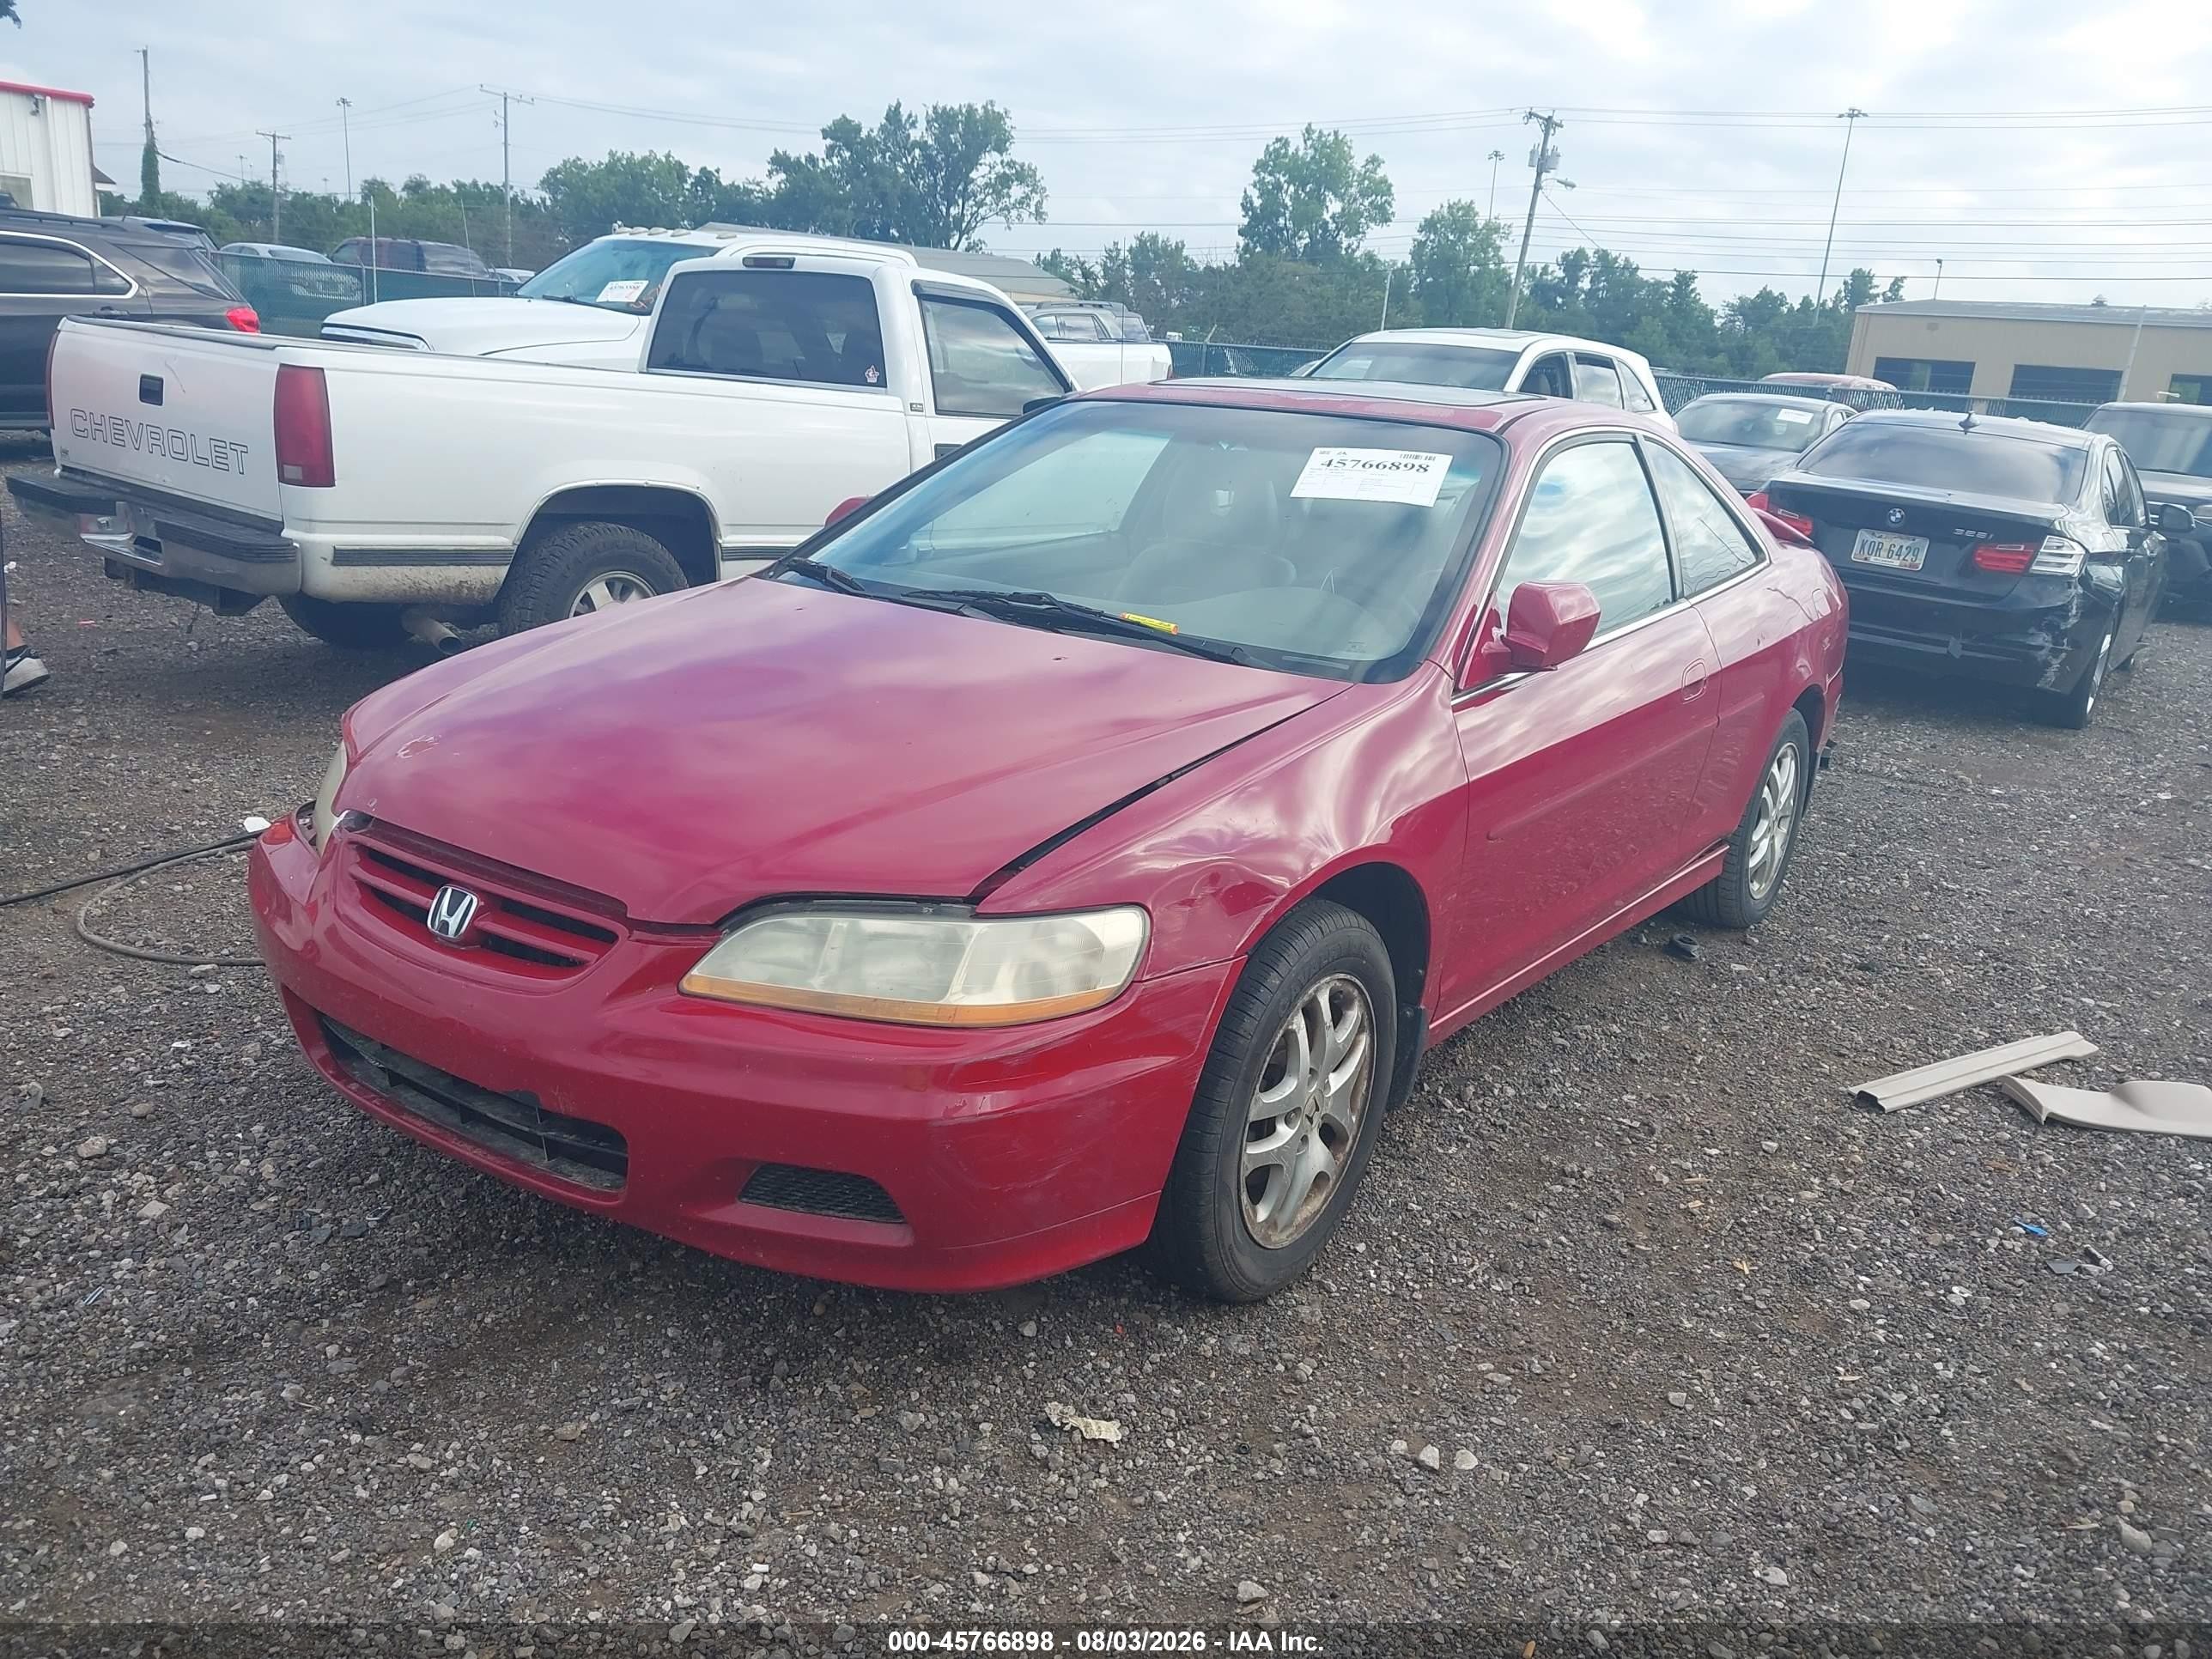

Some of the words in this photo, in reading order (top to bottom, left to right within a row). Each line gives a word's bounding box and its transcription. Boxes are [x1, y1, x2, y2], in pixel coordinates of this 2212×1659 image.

[70, 409, 249, 475] CHEVROLET
[1321, 459, 1430, 473] 45766898
[1859, 538, 1884, 557] KOR
[1887, 543, 1920, 562] 6429
